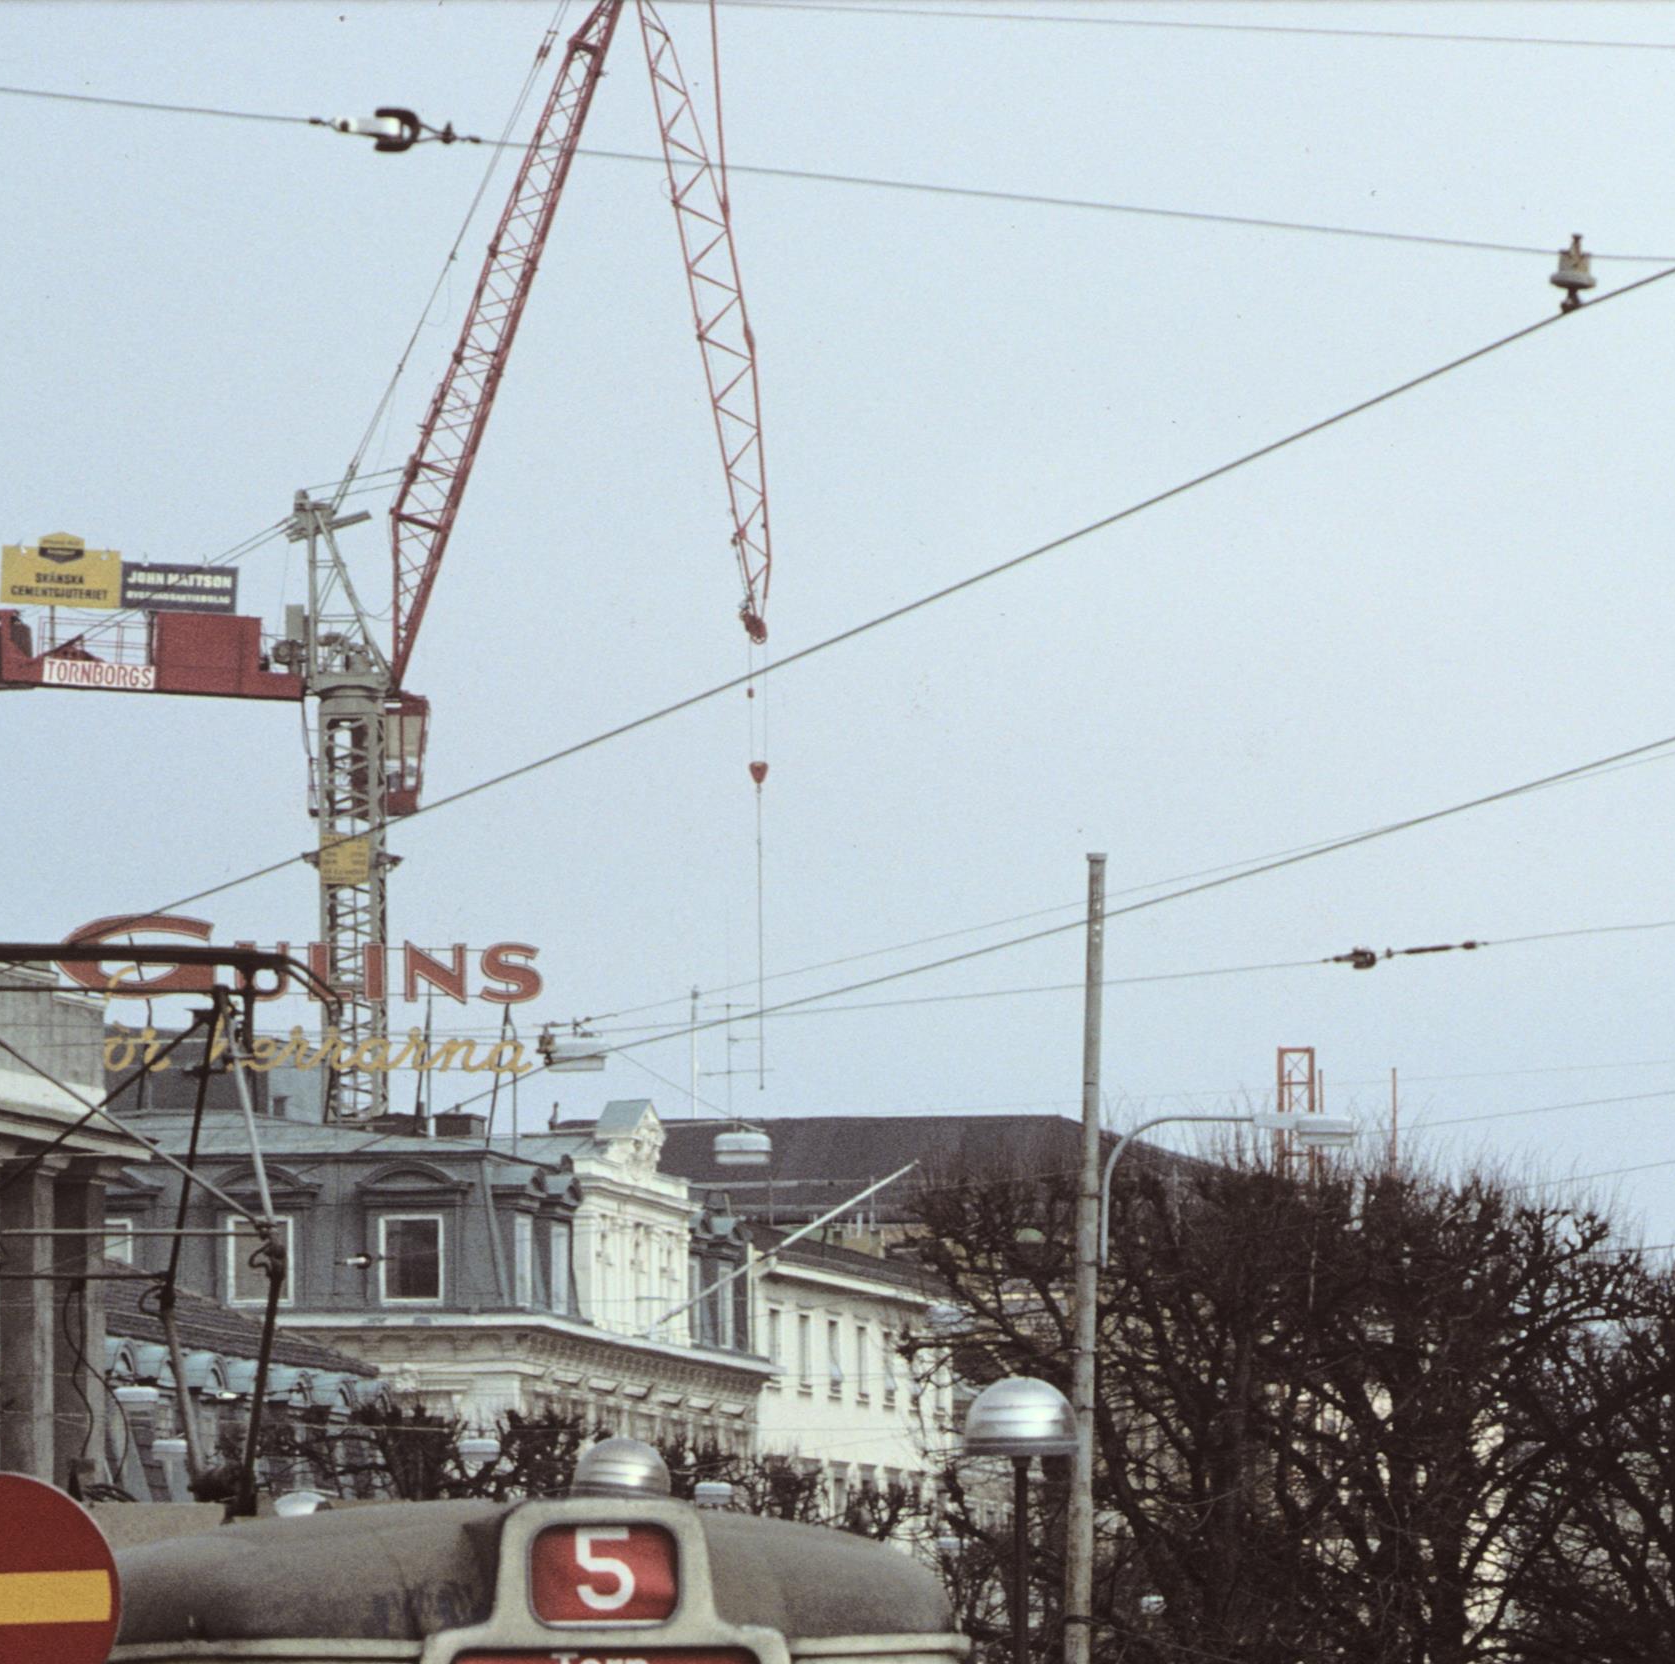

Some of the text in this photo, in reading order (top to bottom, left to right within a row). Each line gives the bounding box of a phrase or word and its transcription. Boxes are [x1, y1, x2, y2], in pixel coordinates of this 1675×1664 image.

[126, 571, 233, 589] JOHN MATTSON
[47, 660, 153, 688] TORNBORGS
[54, 913, 543, 1004] GULINS
[575, 1526, 635, 1611] 5
